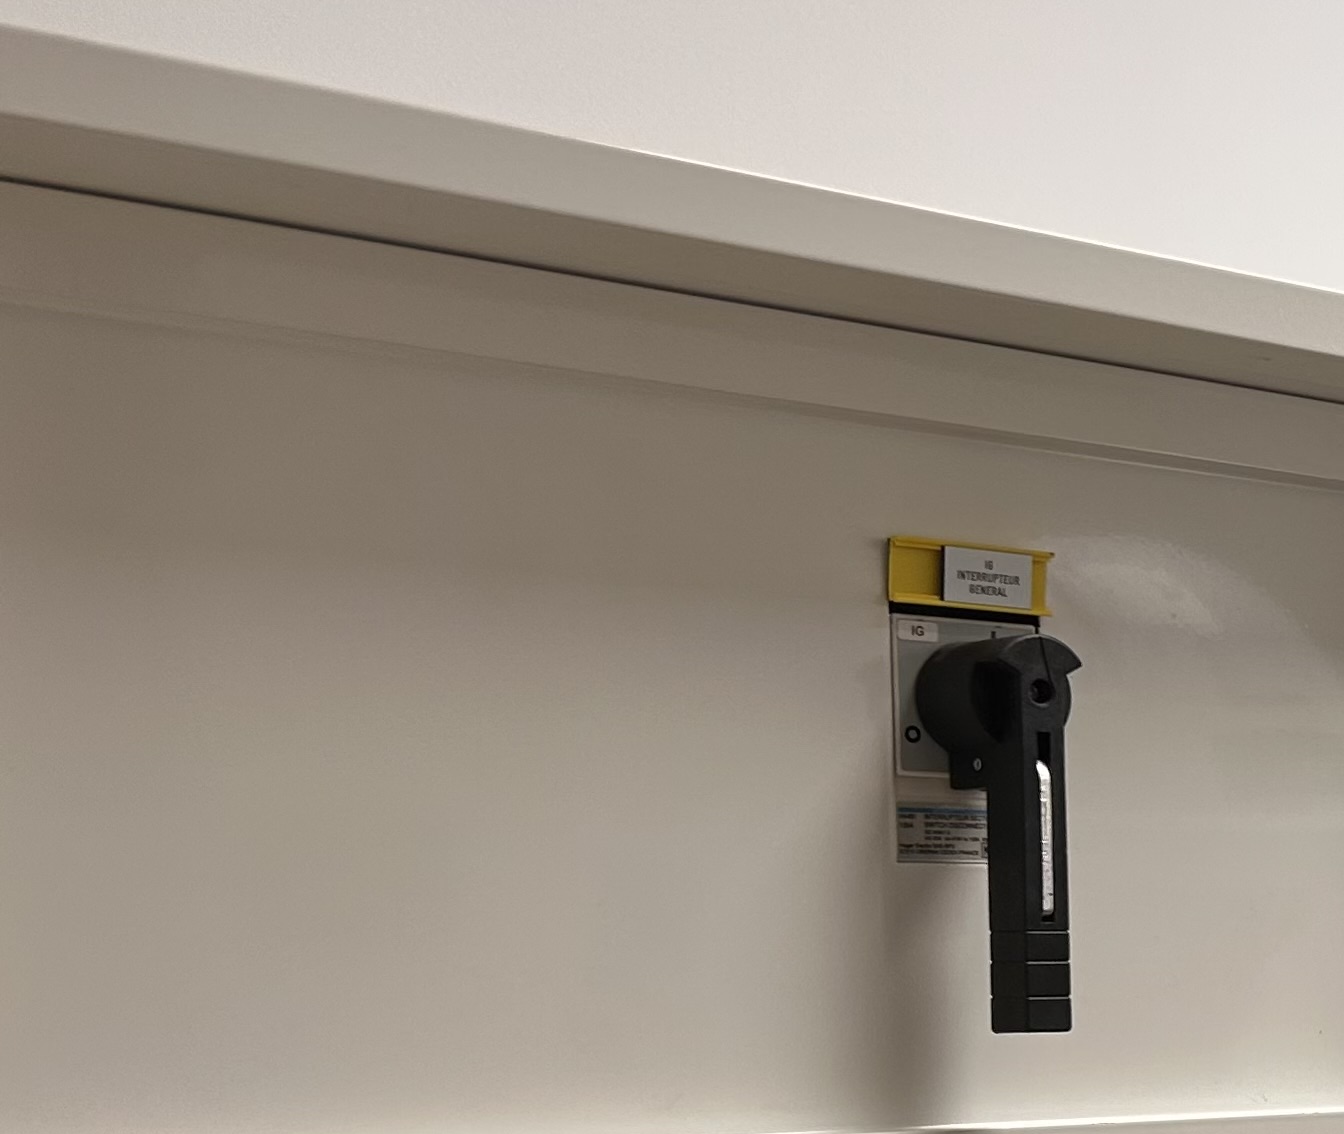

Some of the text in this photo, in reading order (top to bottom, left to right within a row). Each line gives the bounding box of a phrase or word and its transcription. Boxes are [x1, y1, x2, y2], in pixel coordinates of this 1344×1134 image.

[956, 570, 1020, 586] INTERRUPTEUR
[969, 584, 1008, 597] GENERAL
[911, 625, 925, 637] IG
